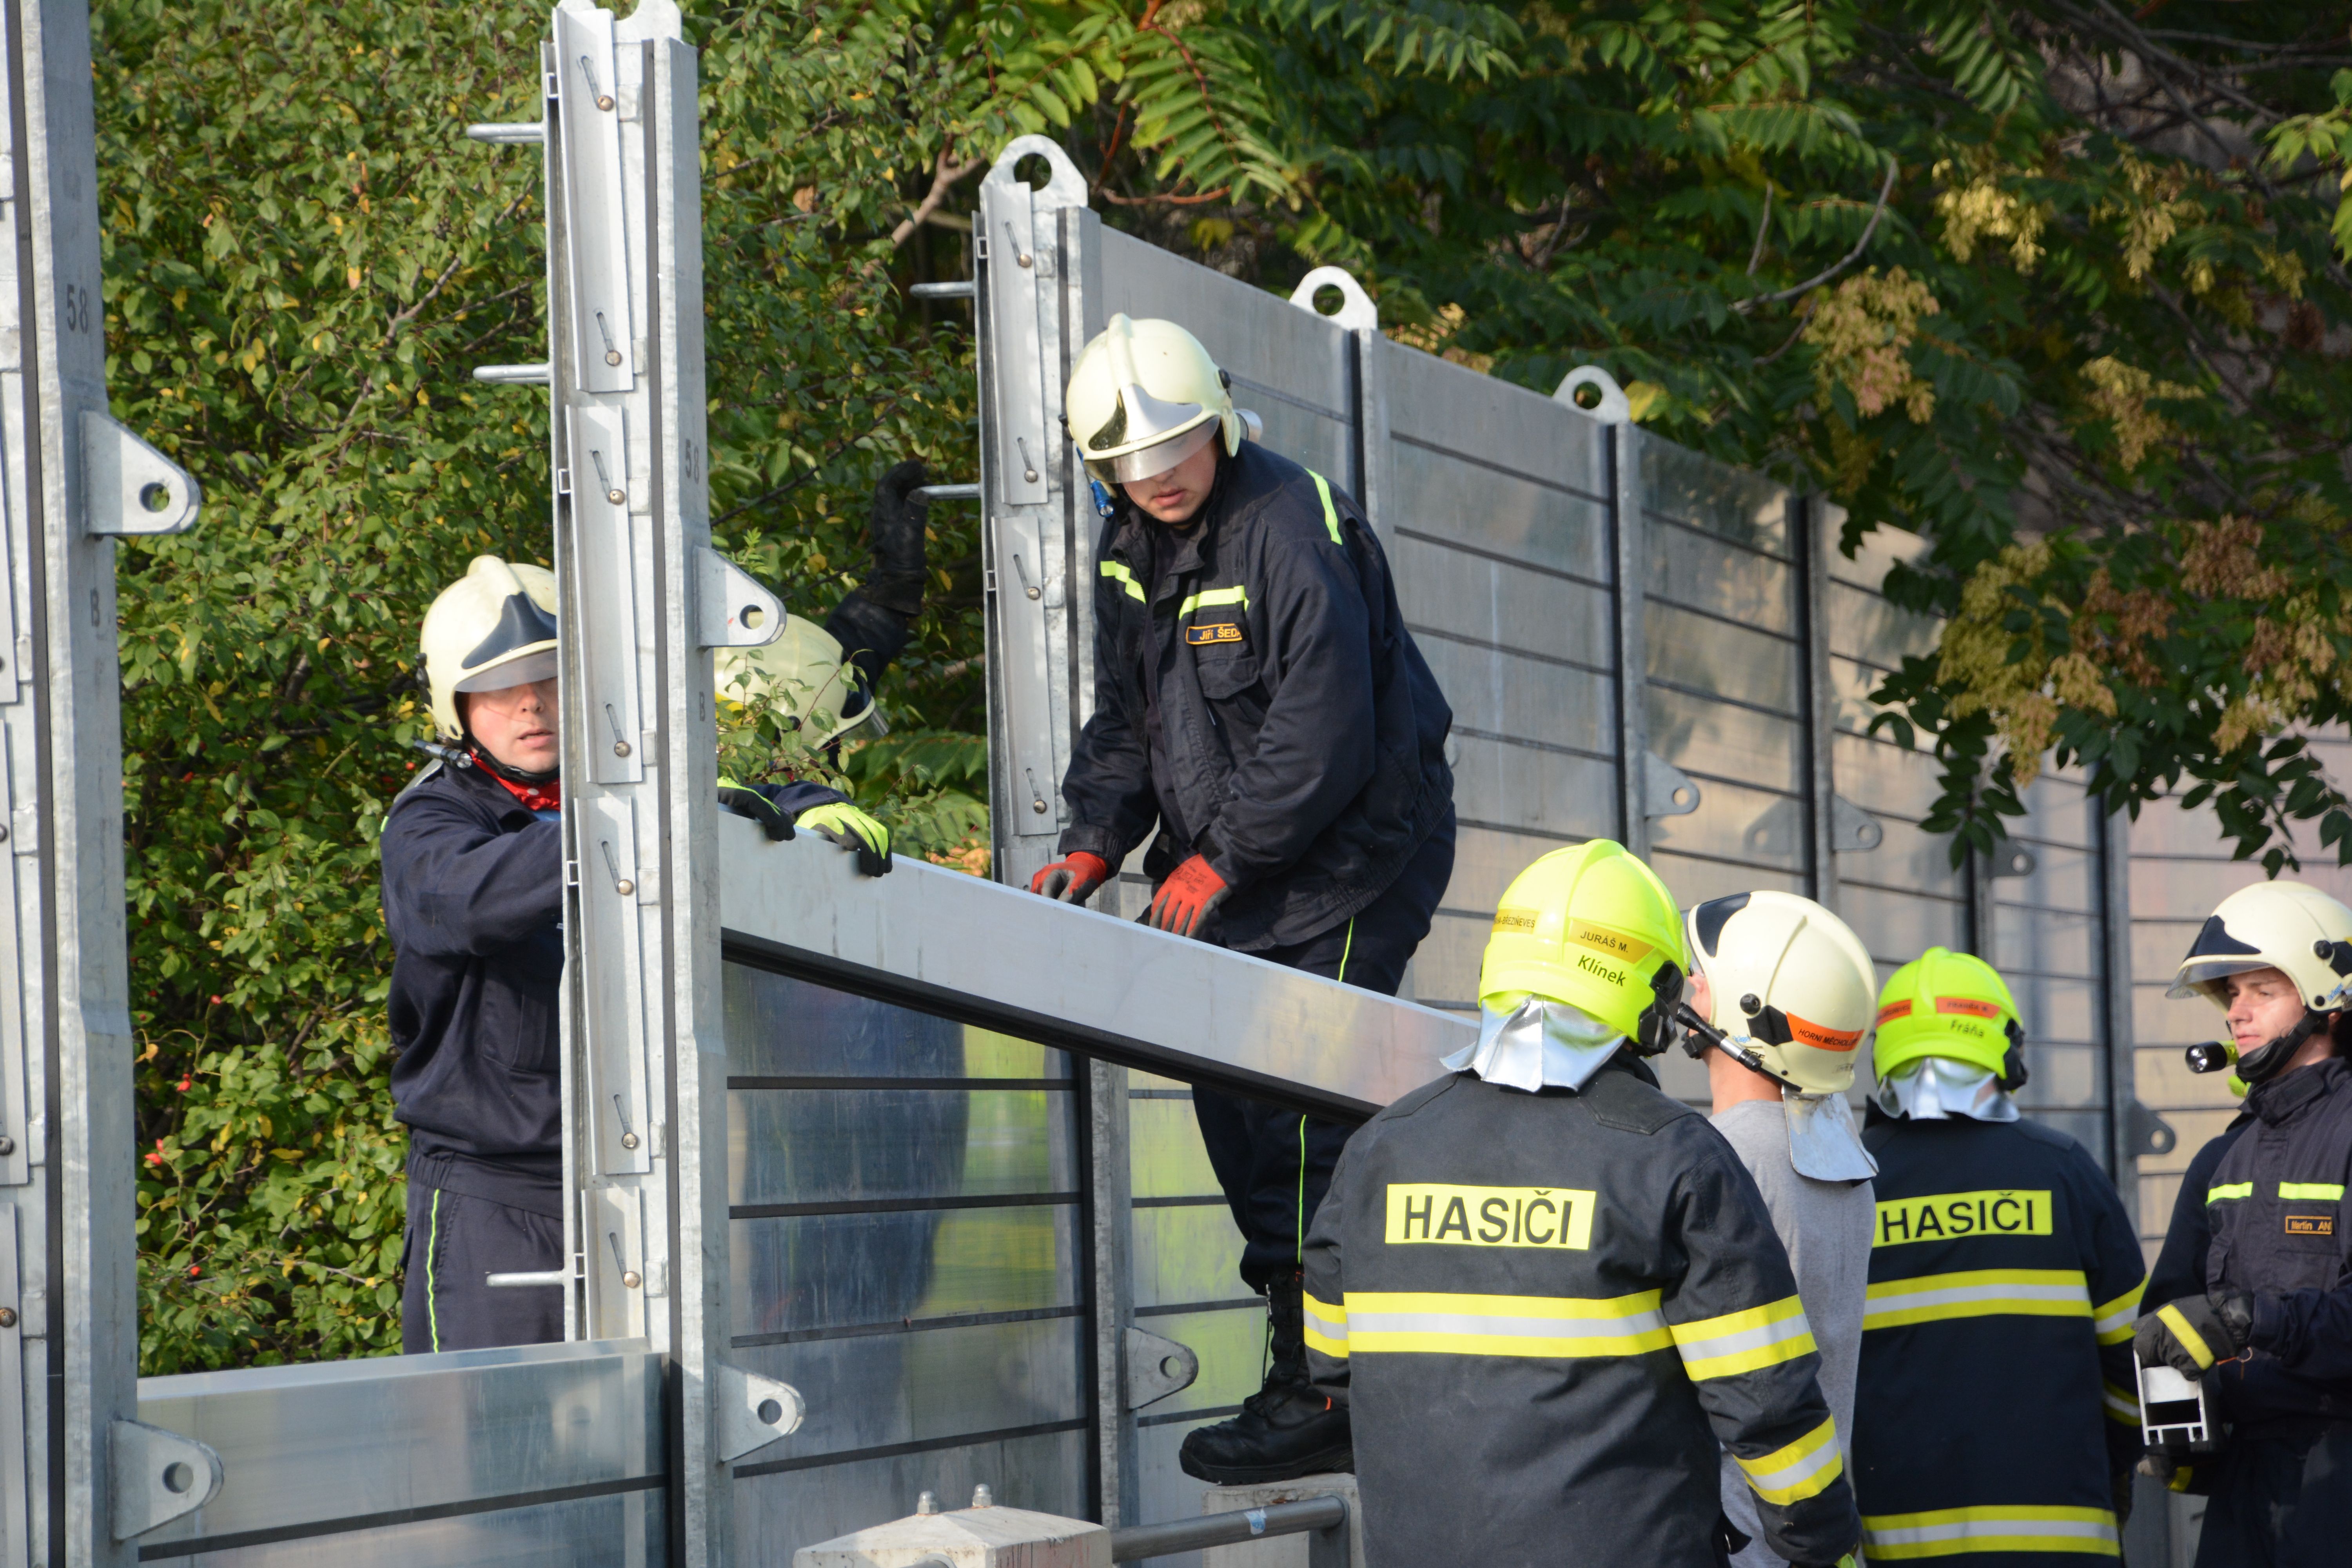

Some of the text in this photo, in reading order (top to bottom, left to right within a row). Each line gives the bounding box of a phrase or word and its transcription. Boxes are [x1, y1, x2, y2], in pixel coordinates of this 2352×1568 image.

[67, 283, 88, 334] 58
[685, 438, 699, 485] 58
[1200, 629, 1214, 640] Jiří
[1580, 931, 1628, 953] JURÁŠ M.
[1577, 955, 1626, 987] Klínek
[1950, 1019, 1984, 1038] Fráňa
[1403, 1190, 1573, 1245] HASIČI
[1882, 1191, 2033, 1242] HASIČI
[2291, 1220, 2313, 1230] Martin
